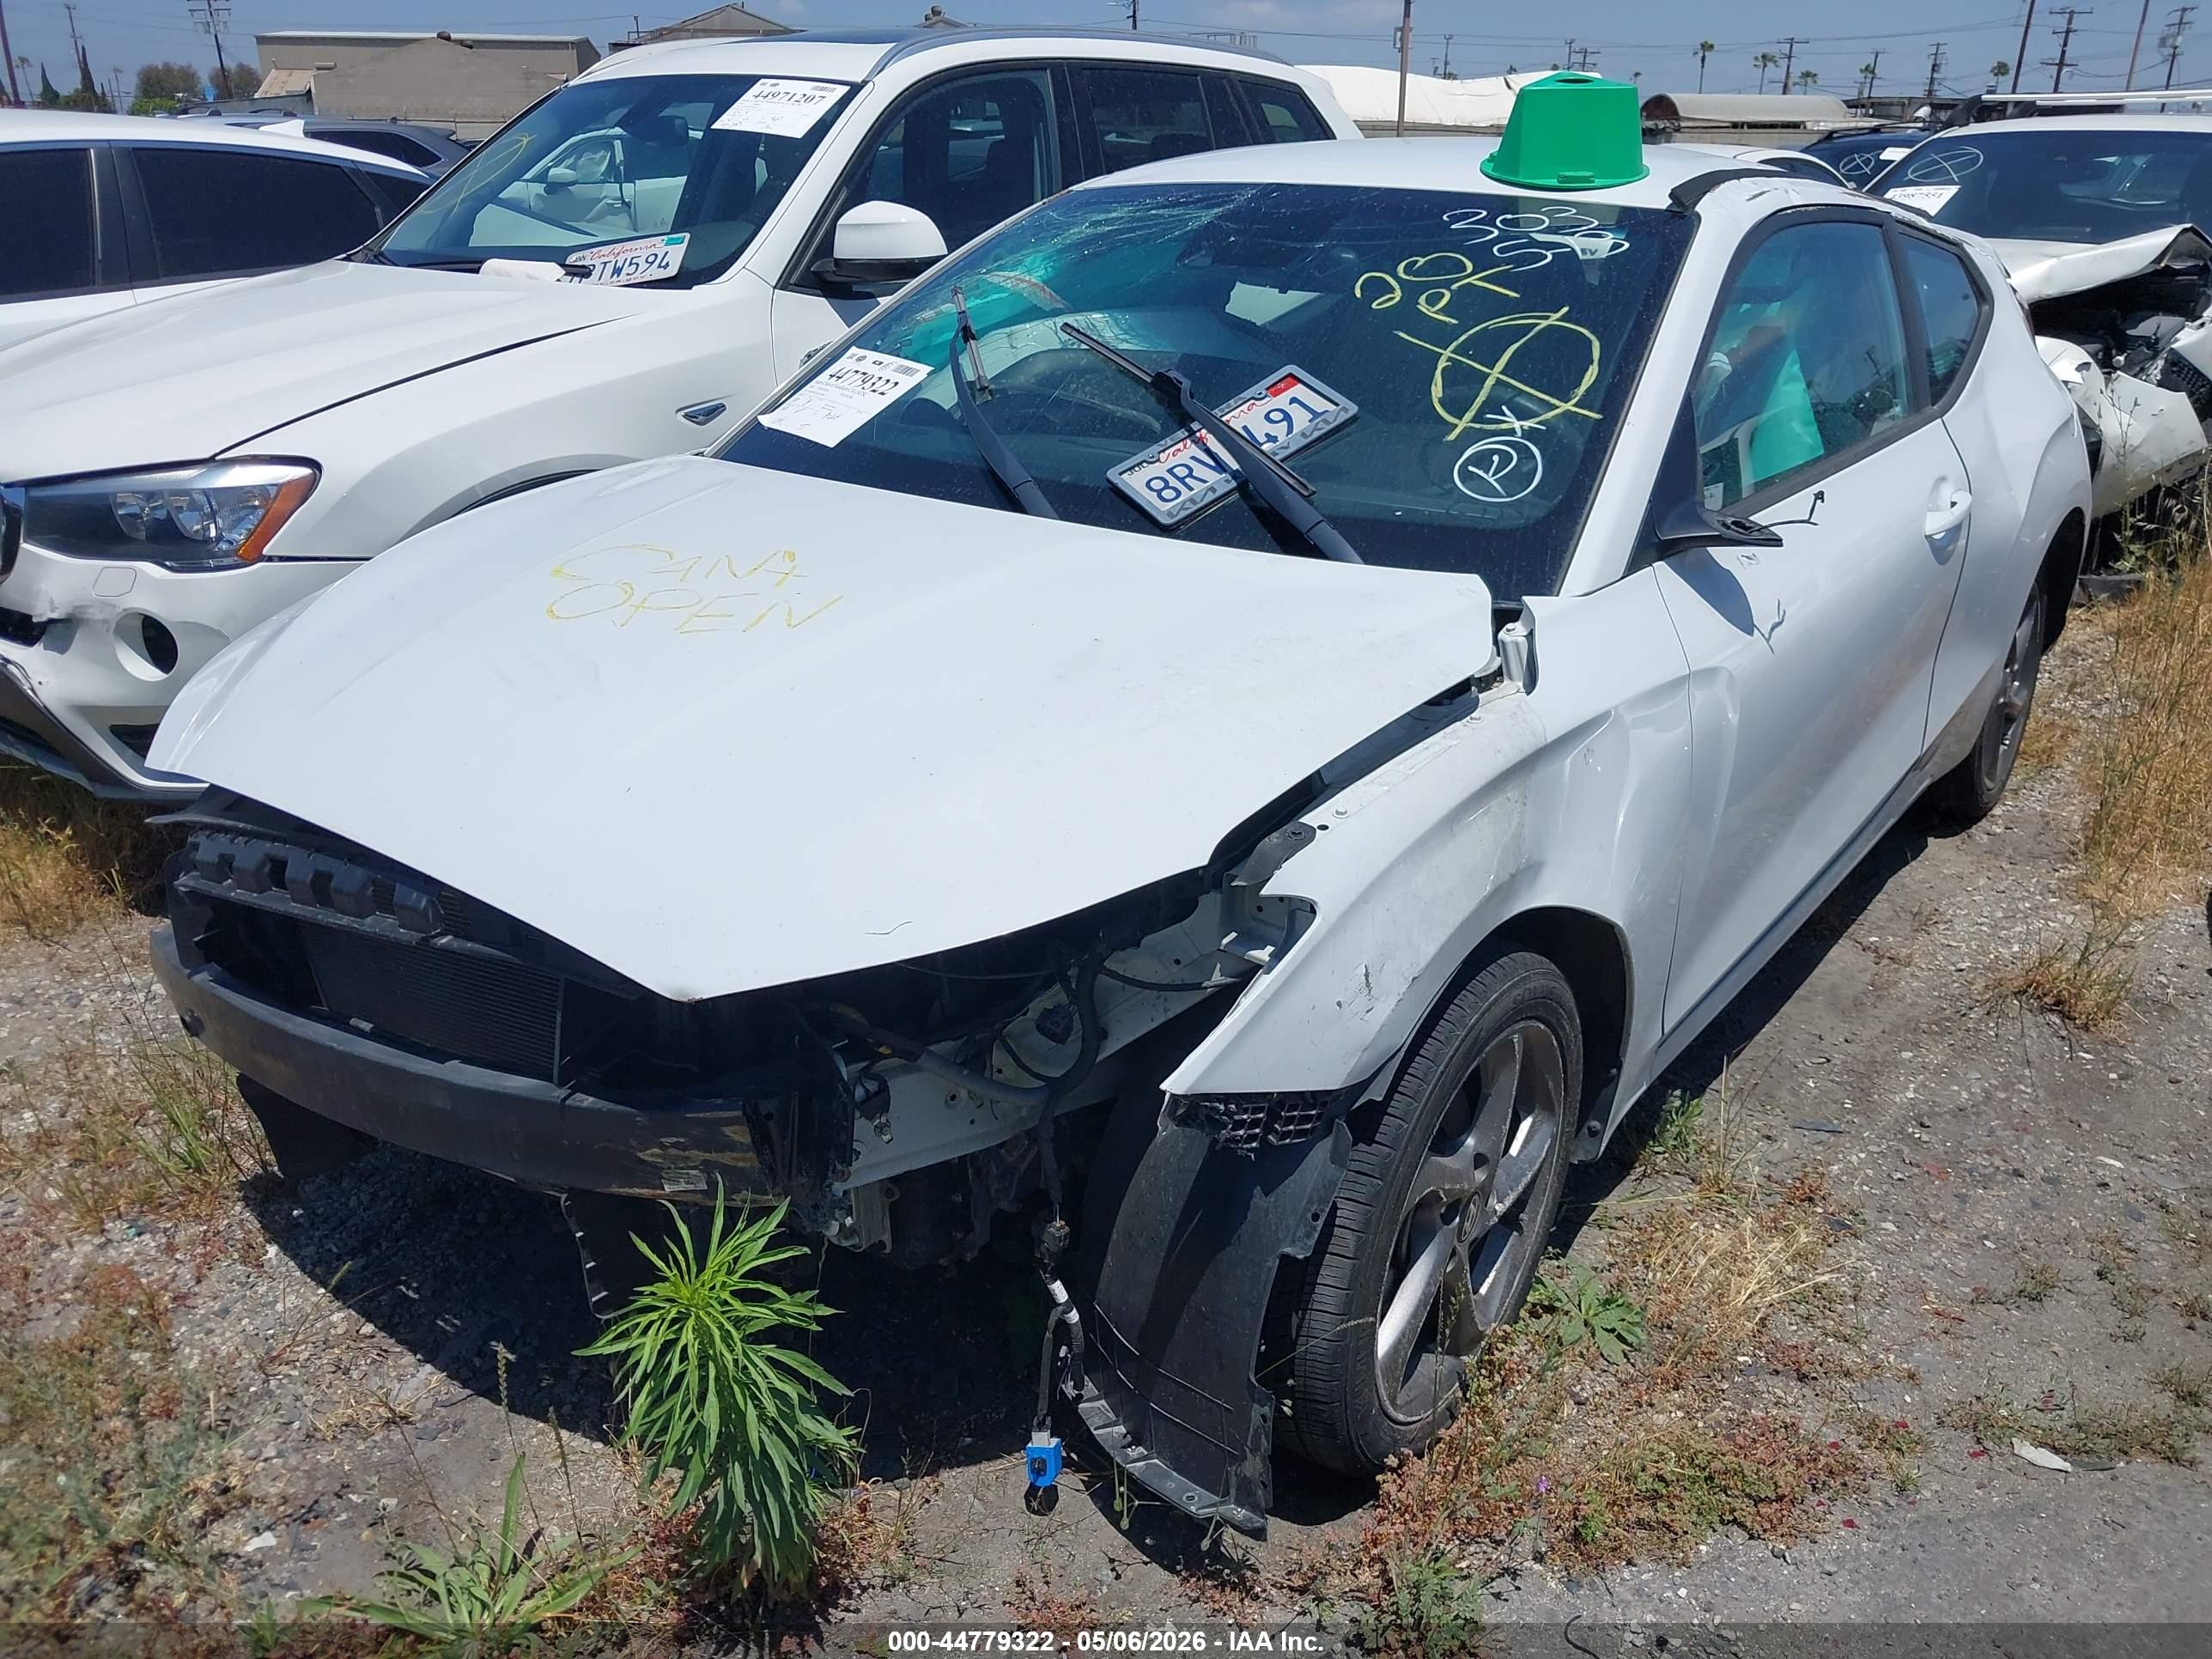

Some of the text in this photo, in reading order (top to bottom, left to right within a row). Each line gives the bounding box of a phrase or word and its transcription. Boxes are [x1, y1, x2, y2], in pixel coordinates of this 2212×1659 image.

[752, 90, 827, 105] 44971207
[1443, 206, 1600, 246] 303
[590, 241, 665, 261] California
[827, 366, 900, 396] 44779322
[1145, 396, 1331, 503] 8RV491
[1157, 398, 1273, 465] Califnia
[545, 580, 845, 634] OPEN
